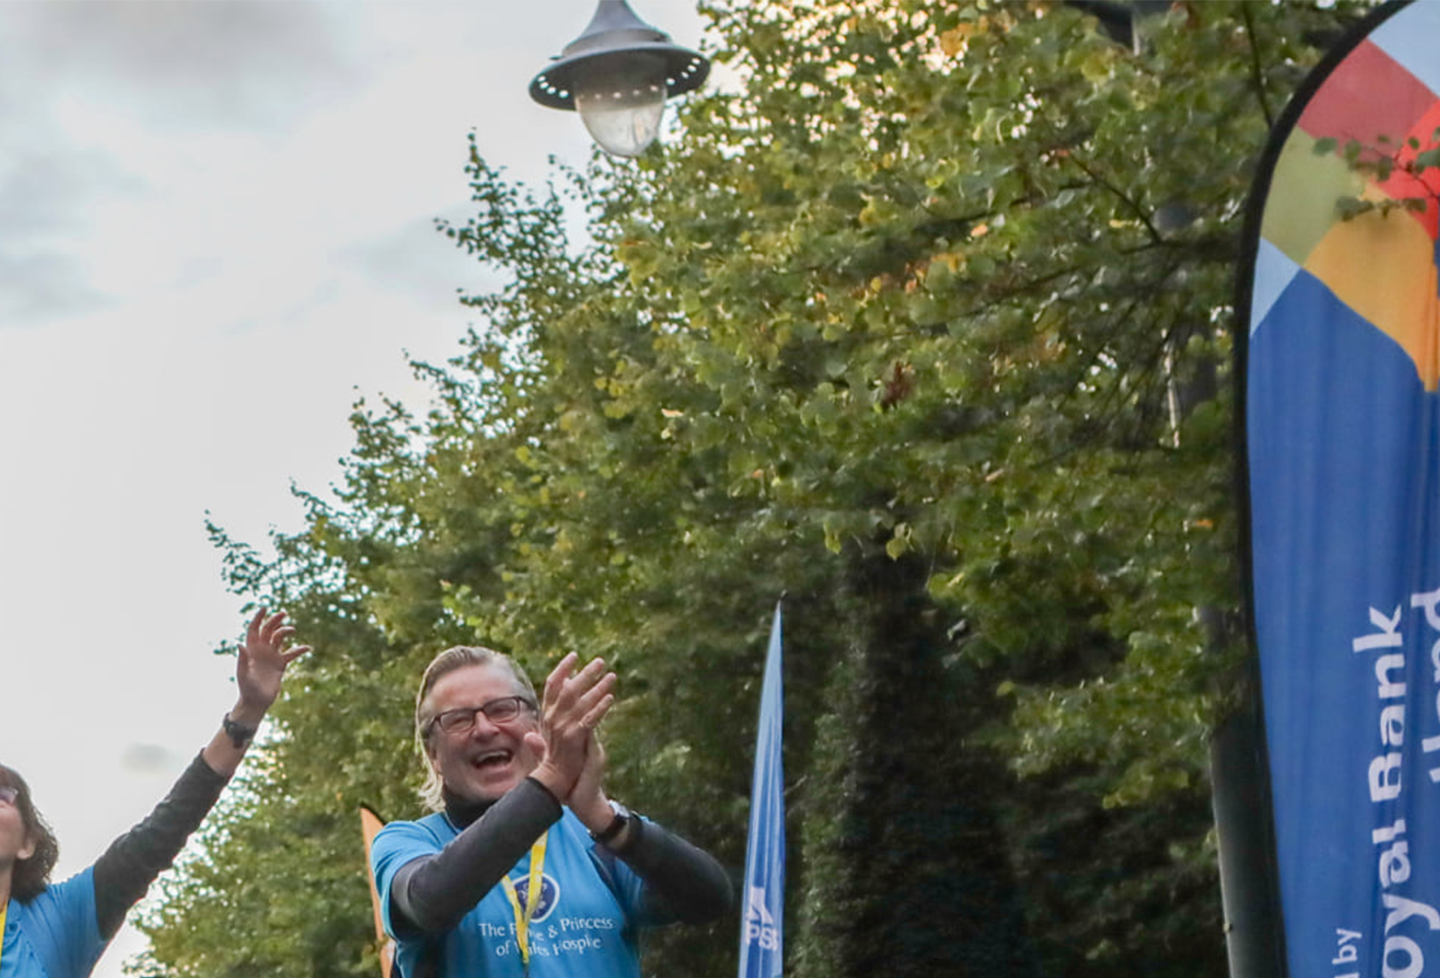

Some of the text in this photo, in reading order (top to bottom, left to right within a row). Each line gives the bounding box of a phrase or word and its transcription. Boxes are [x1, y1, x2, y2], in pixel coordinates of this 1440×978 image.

[1353, 603, 1407, 803] Bank
[479, 922, 505, 938] The
[547, 924, 558, 939] &
[560, 915, 613, 932] Princess
[496, 940, 510, 957] of
[1332, 927, 1363, 966] by
